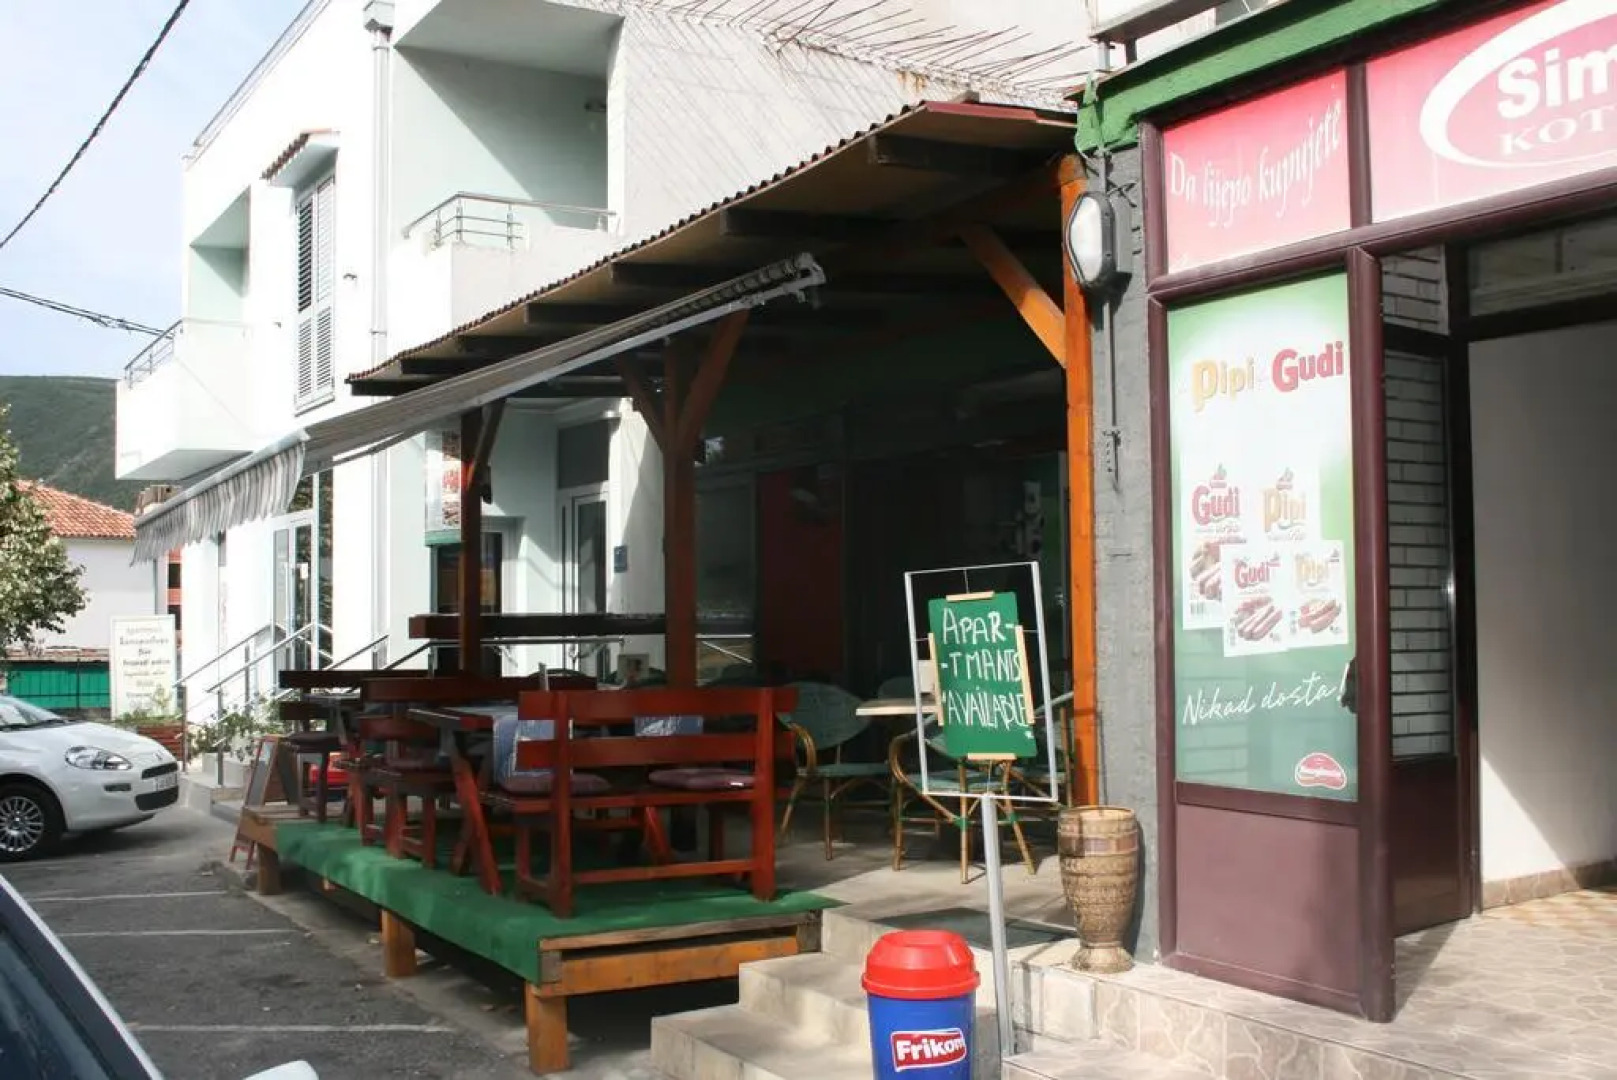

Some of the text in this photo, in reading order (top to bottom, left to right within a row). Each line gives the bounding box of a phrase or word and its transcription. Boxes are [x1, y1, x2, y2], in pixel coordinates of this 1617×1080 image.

[1192, 340, 1344, 413] Pipi Gudi
[1192, 485, 1241, 526] Gudi
[1234, 558, 1271, 589] Gudi
[1182, 687, 1257, 726] Nikad
